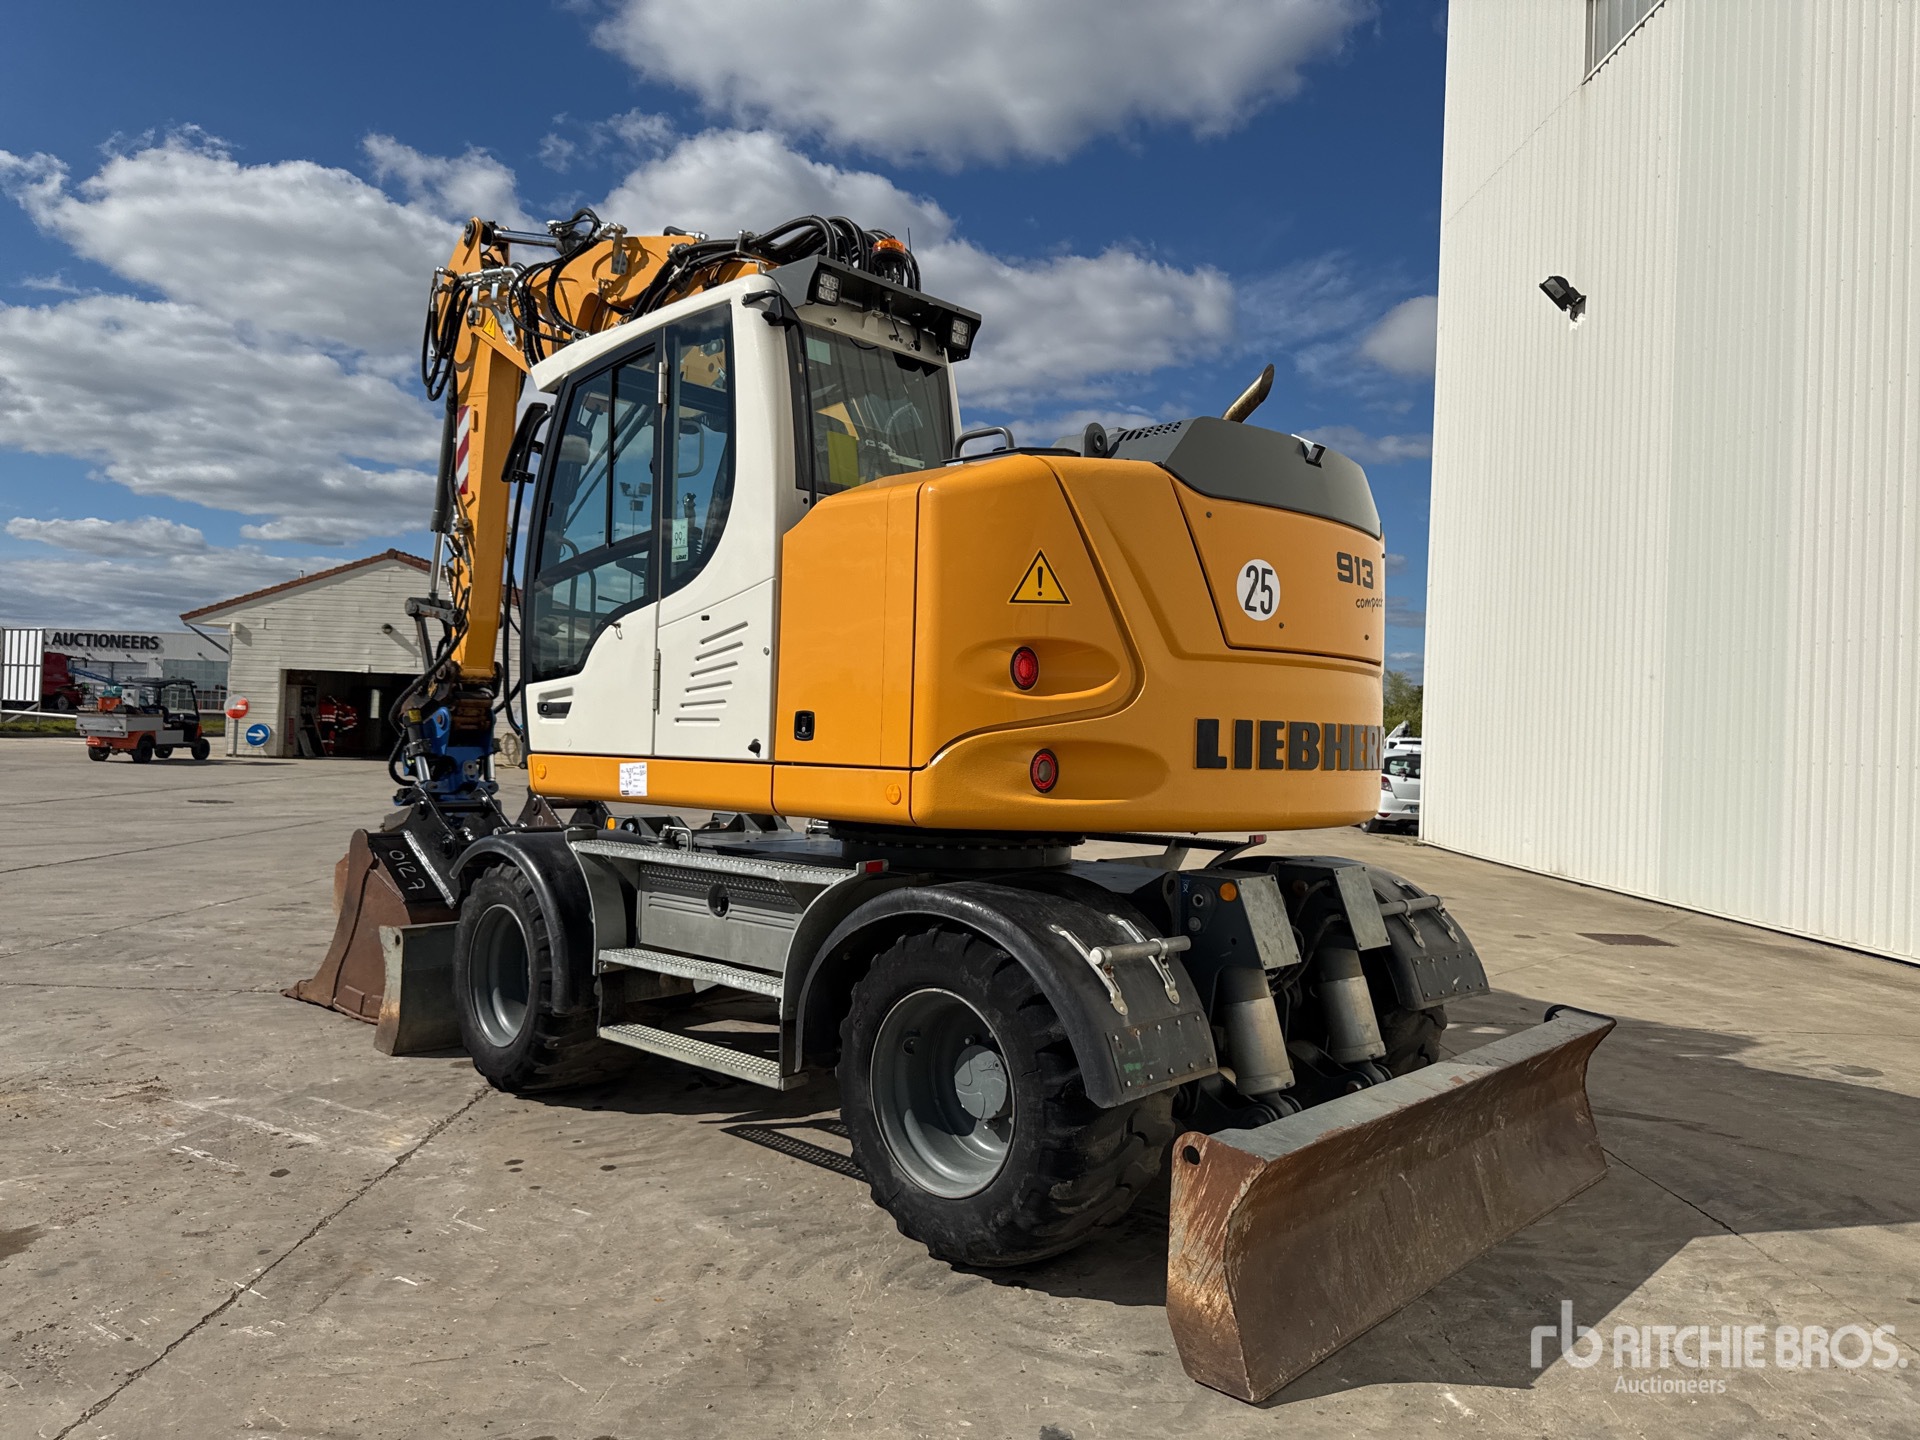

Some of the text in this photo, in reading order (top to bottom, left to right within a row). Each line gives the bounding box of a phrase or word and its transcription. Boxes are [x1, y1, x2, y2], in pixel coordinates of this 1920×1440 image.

[1336, 552, 1374, 589] 913
[1244, 565, 1273, 615] 25
[51, 632, 160, 650] AUCTIONEERS
